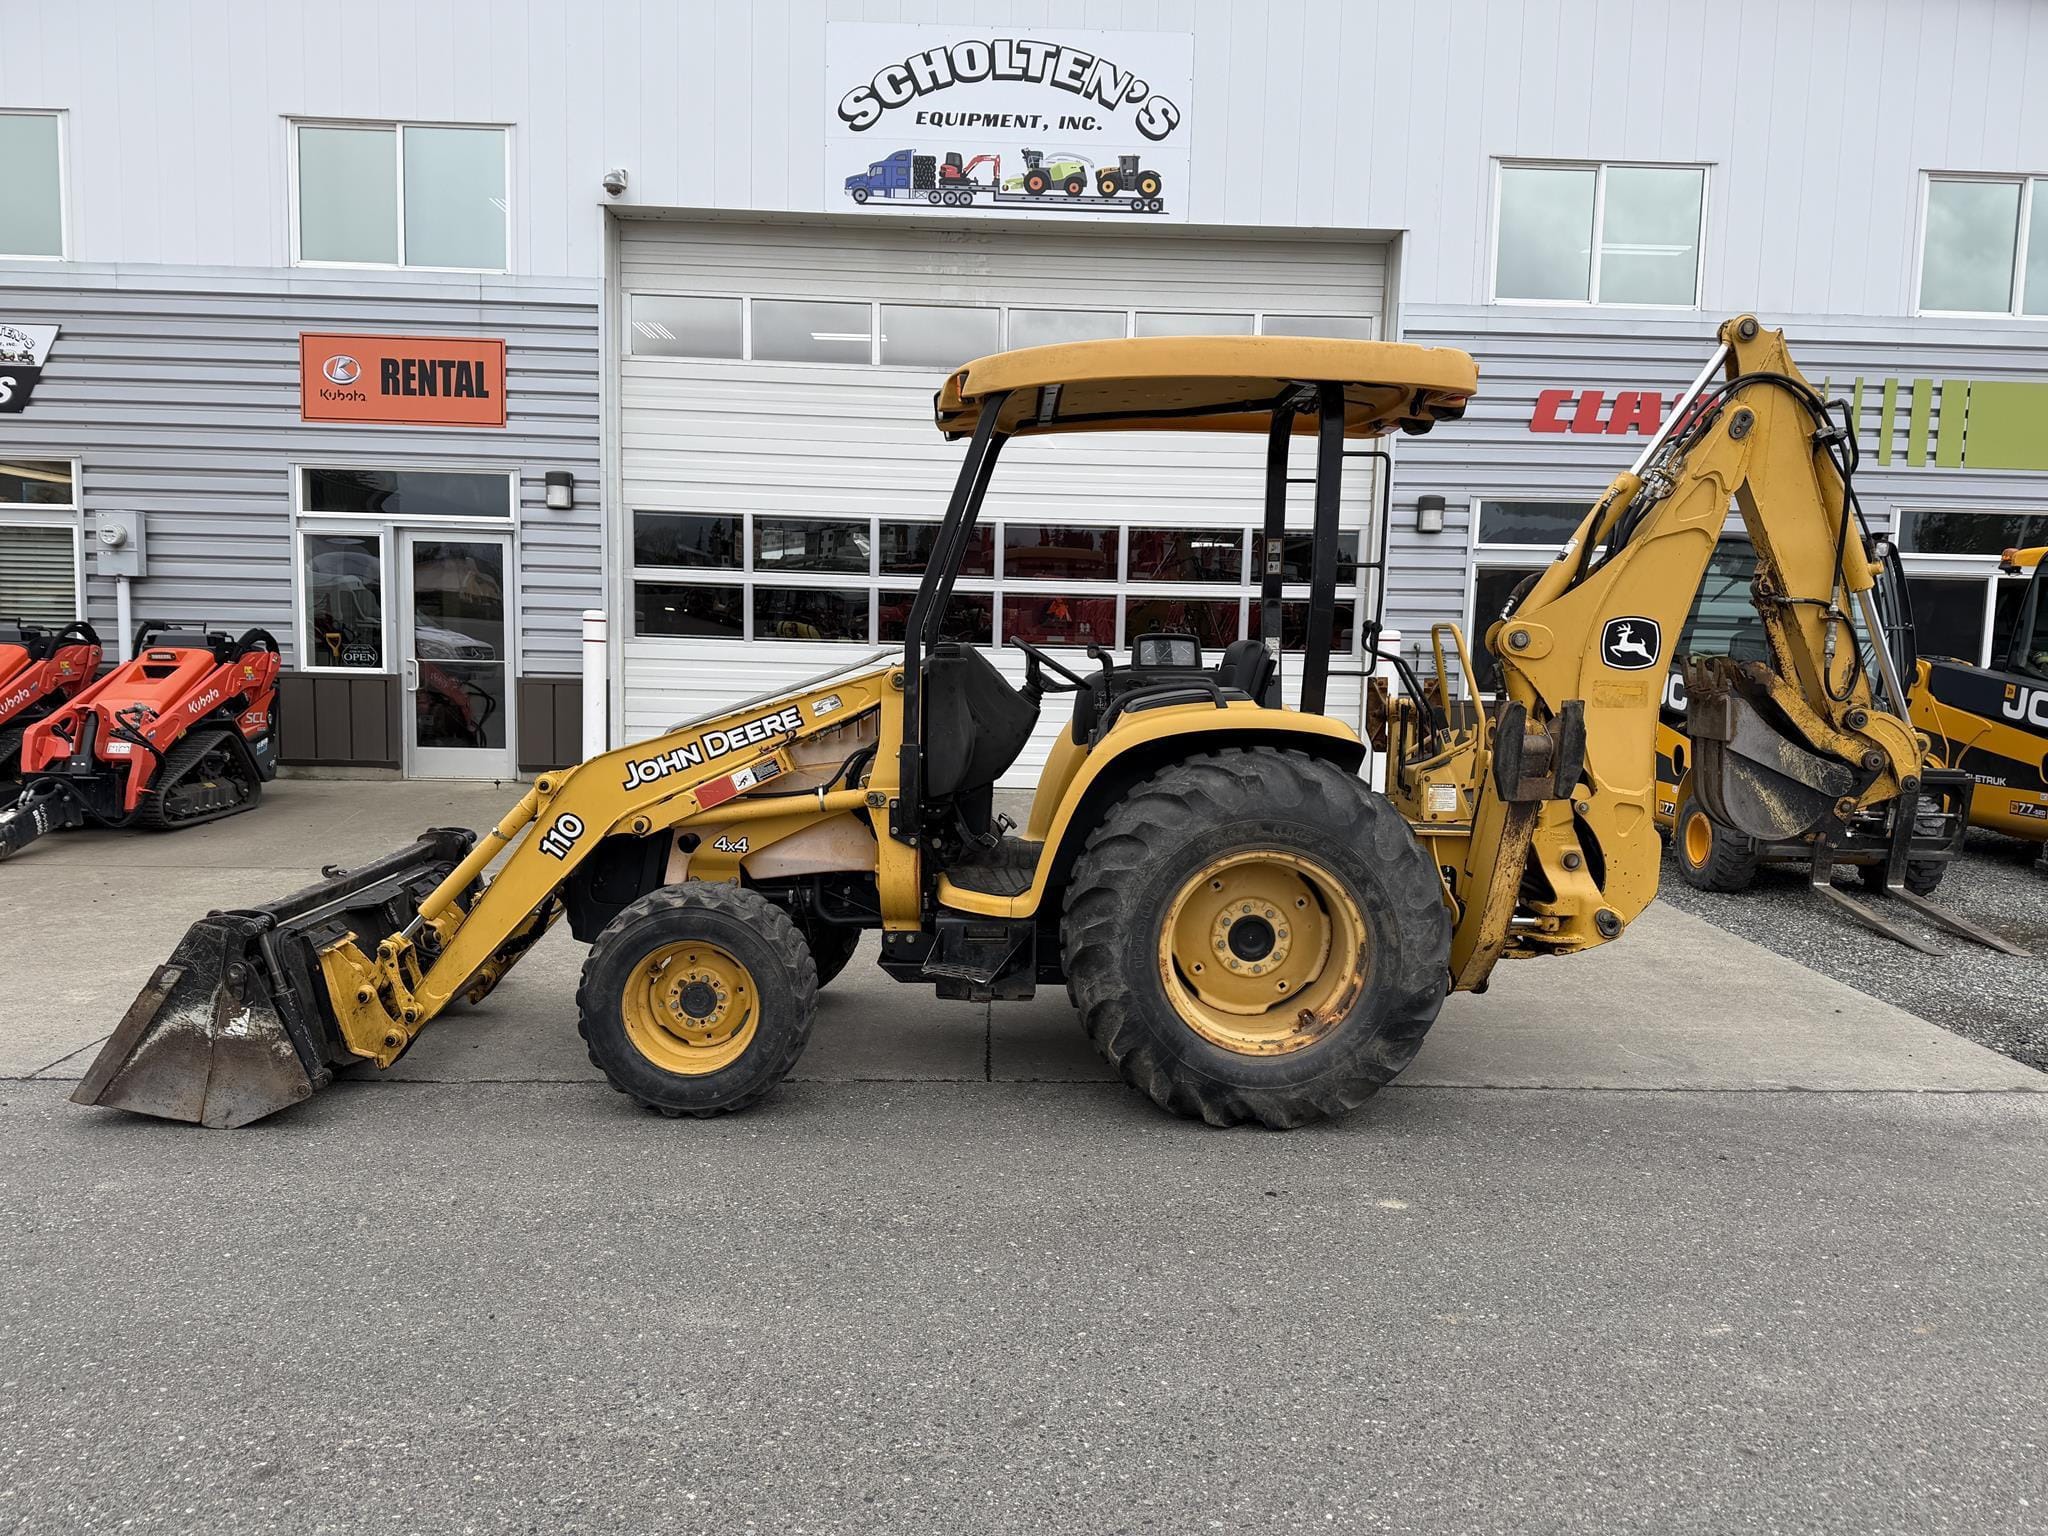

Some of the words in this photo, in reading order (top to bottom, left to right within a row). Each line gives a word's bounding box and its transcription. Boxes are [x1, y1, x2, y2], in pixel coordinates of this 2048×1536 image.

[837, 39, 1181, 141] SCHOLTEN'S
[915, 111, 1049, 131] EQUIPMENT,
[1058, 115, 1103, 131] INC.
[380, 357, 490, 399] RENTAL
[319, 388, 366, 402] Kubota
[343, 652, 376, 661] OPEN
[187, 688, 219, 713] Kubota
[244, 711, 267, 724] SCL
[621, 741, 704, 791] JOHN
[700, 704, 804, 760] DEERE
[538, 812, 586, 861] 110
[712, 836, 749, 853] 4x4
